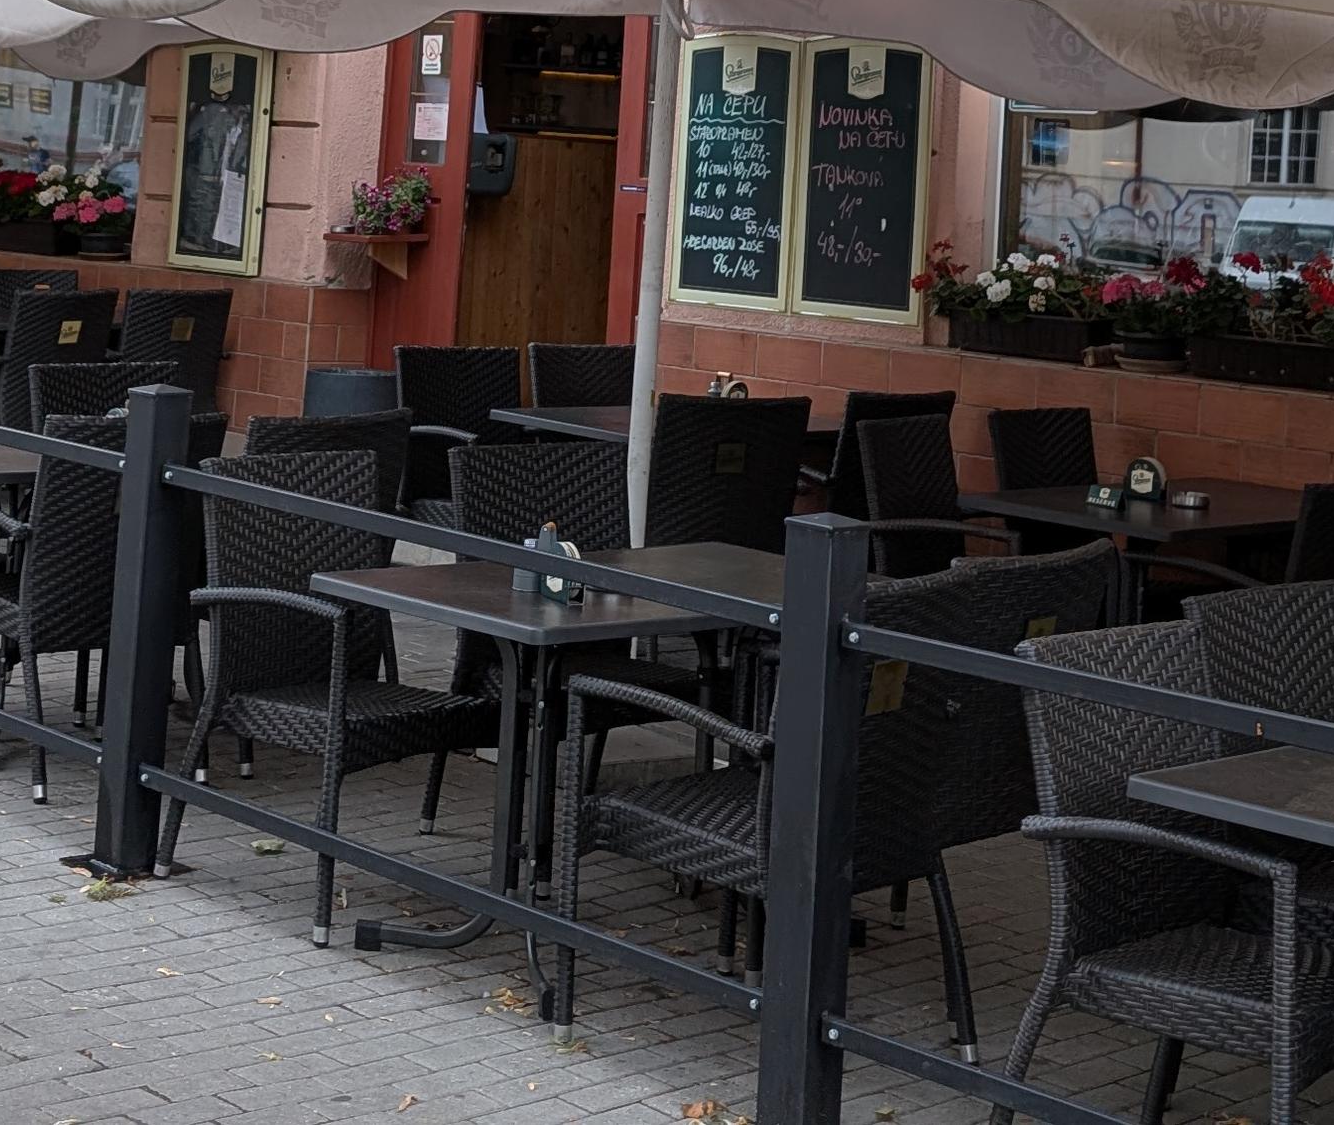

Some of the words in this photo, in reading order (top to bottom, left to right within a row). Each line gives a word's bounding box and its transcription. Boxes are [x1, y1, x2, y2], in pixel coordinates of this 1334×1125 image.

[694, 93, 714, 116] NA
[723, 93, 767, 117] ČEPU
[818, 102, 893, 128] NOVINKA
[838, 130, 861, 150] NA
